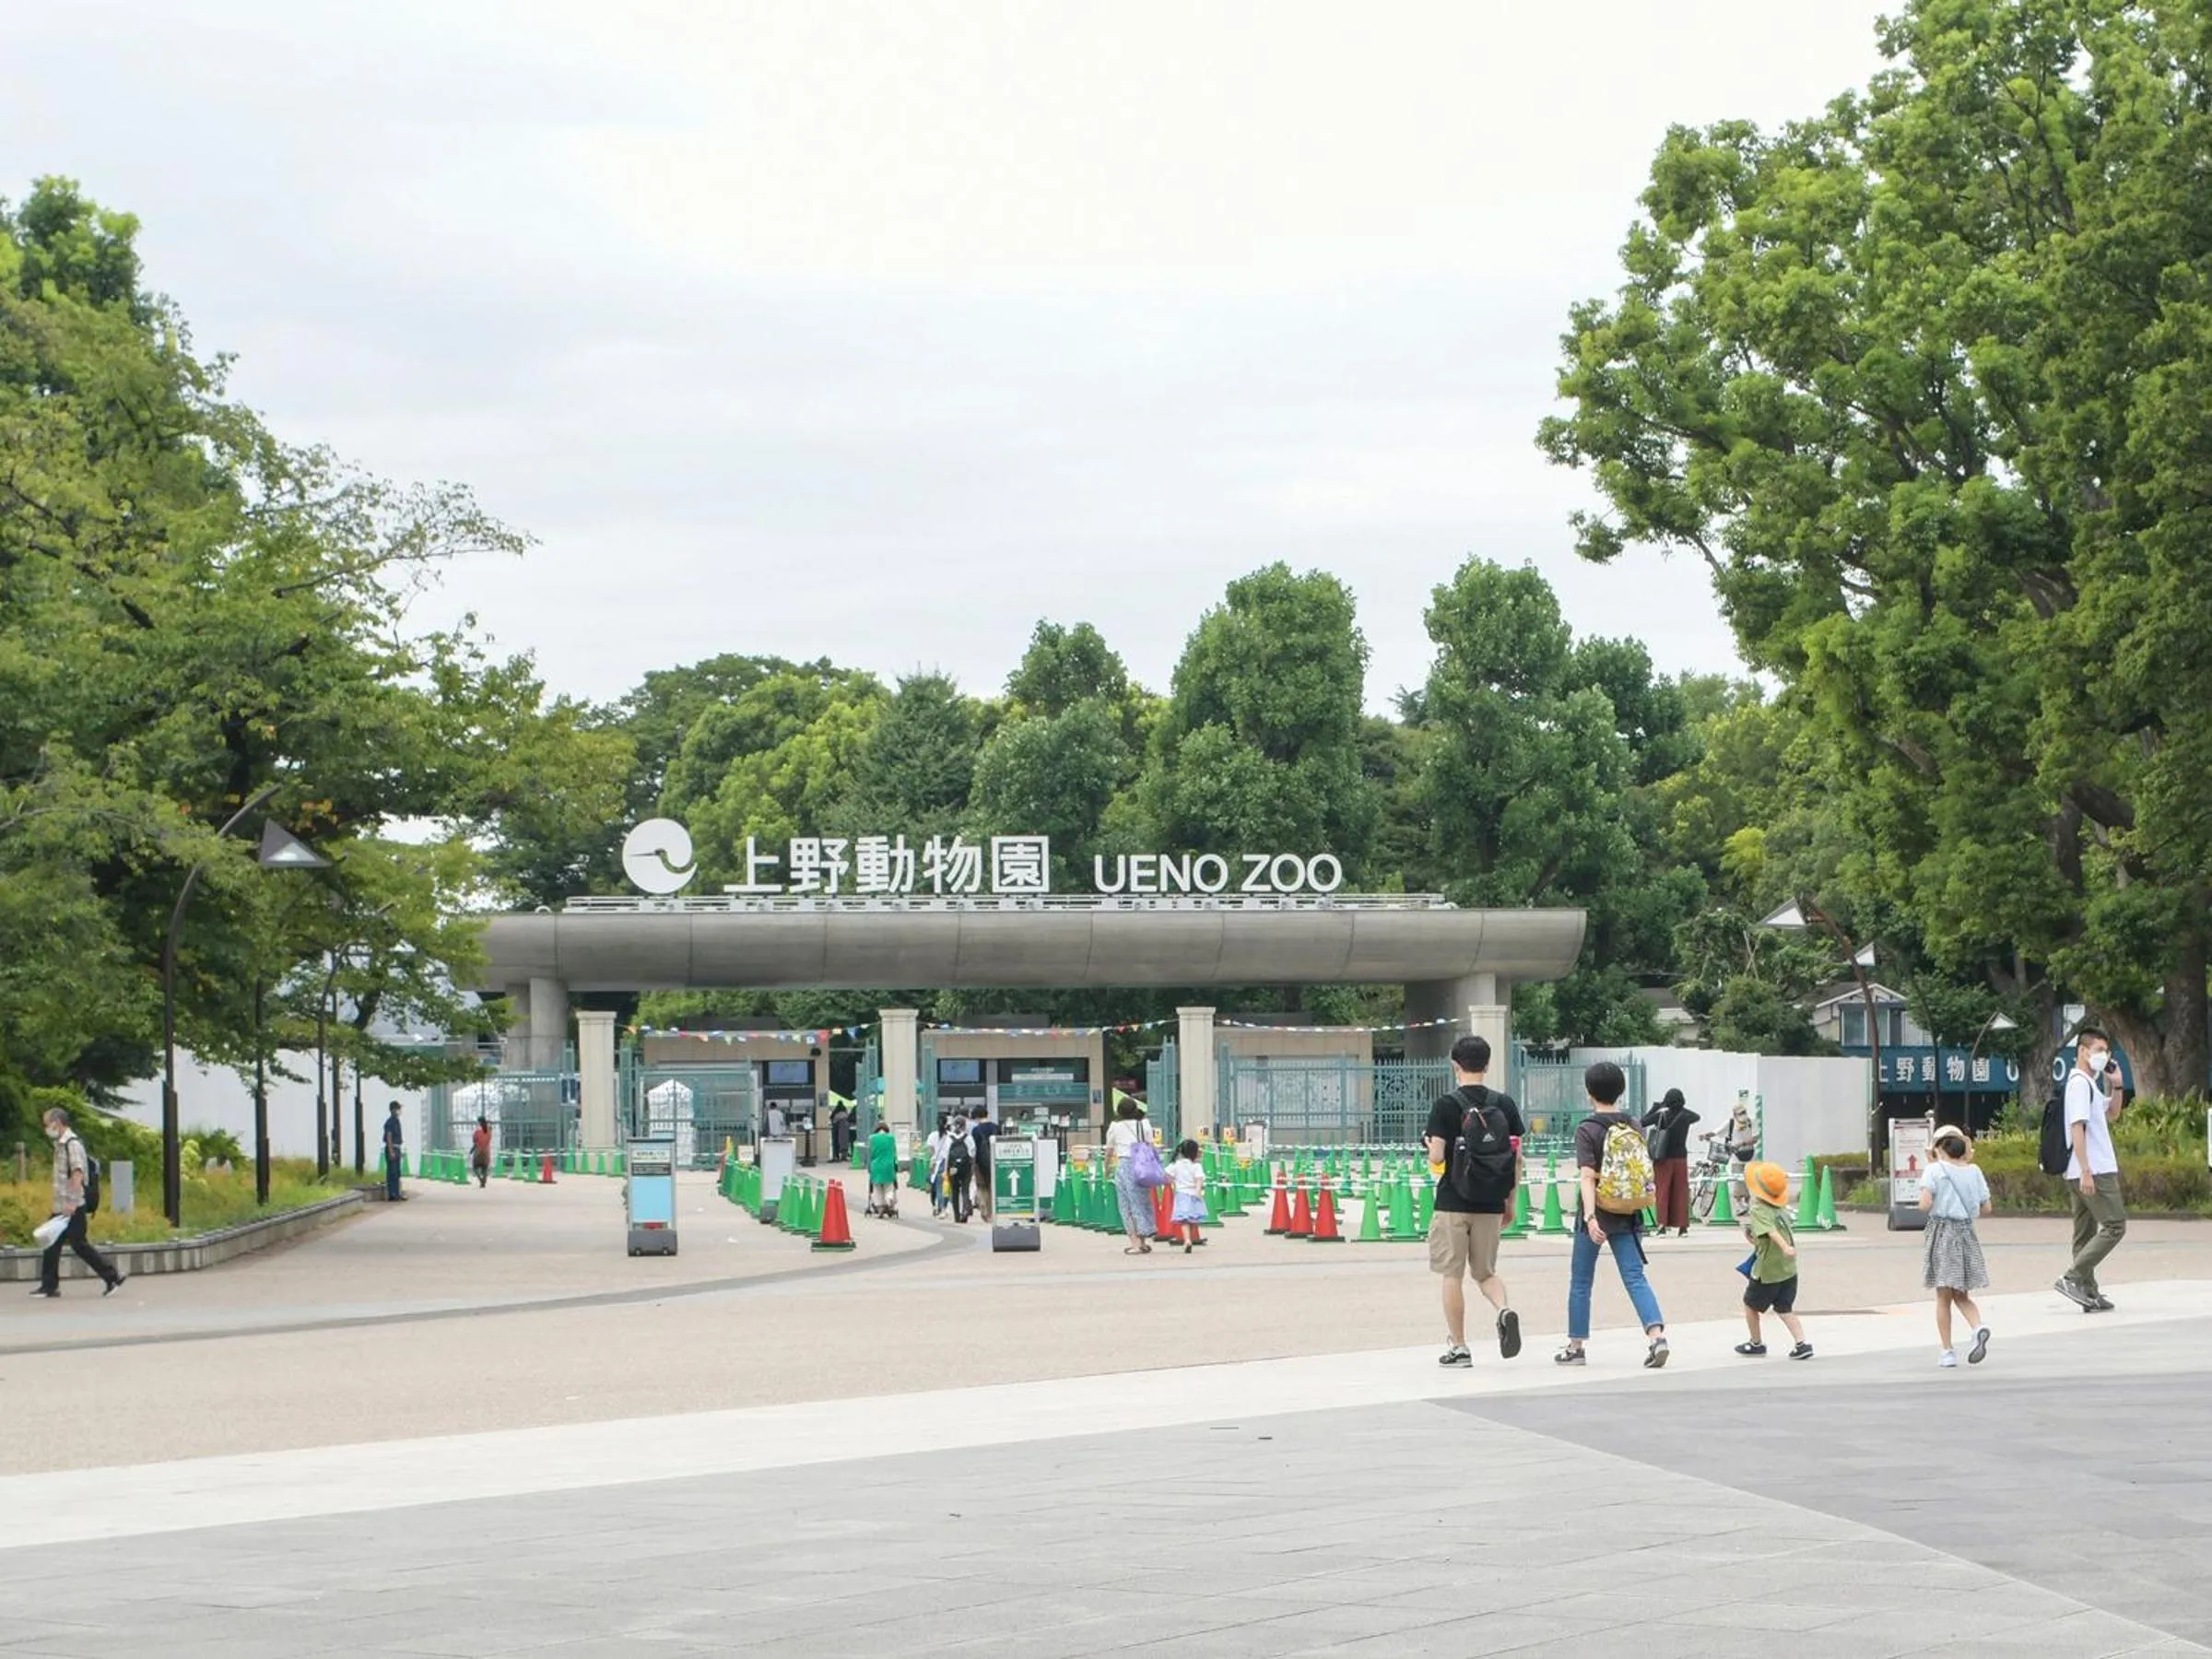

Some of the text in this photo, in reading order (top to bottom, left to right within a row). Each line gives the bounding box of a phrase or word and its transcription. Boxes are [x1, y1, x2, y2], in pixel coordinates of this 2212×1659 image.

[723, 834, 1343, 893] 上野動物園 UENO ZOO
